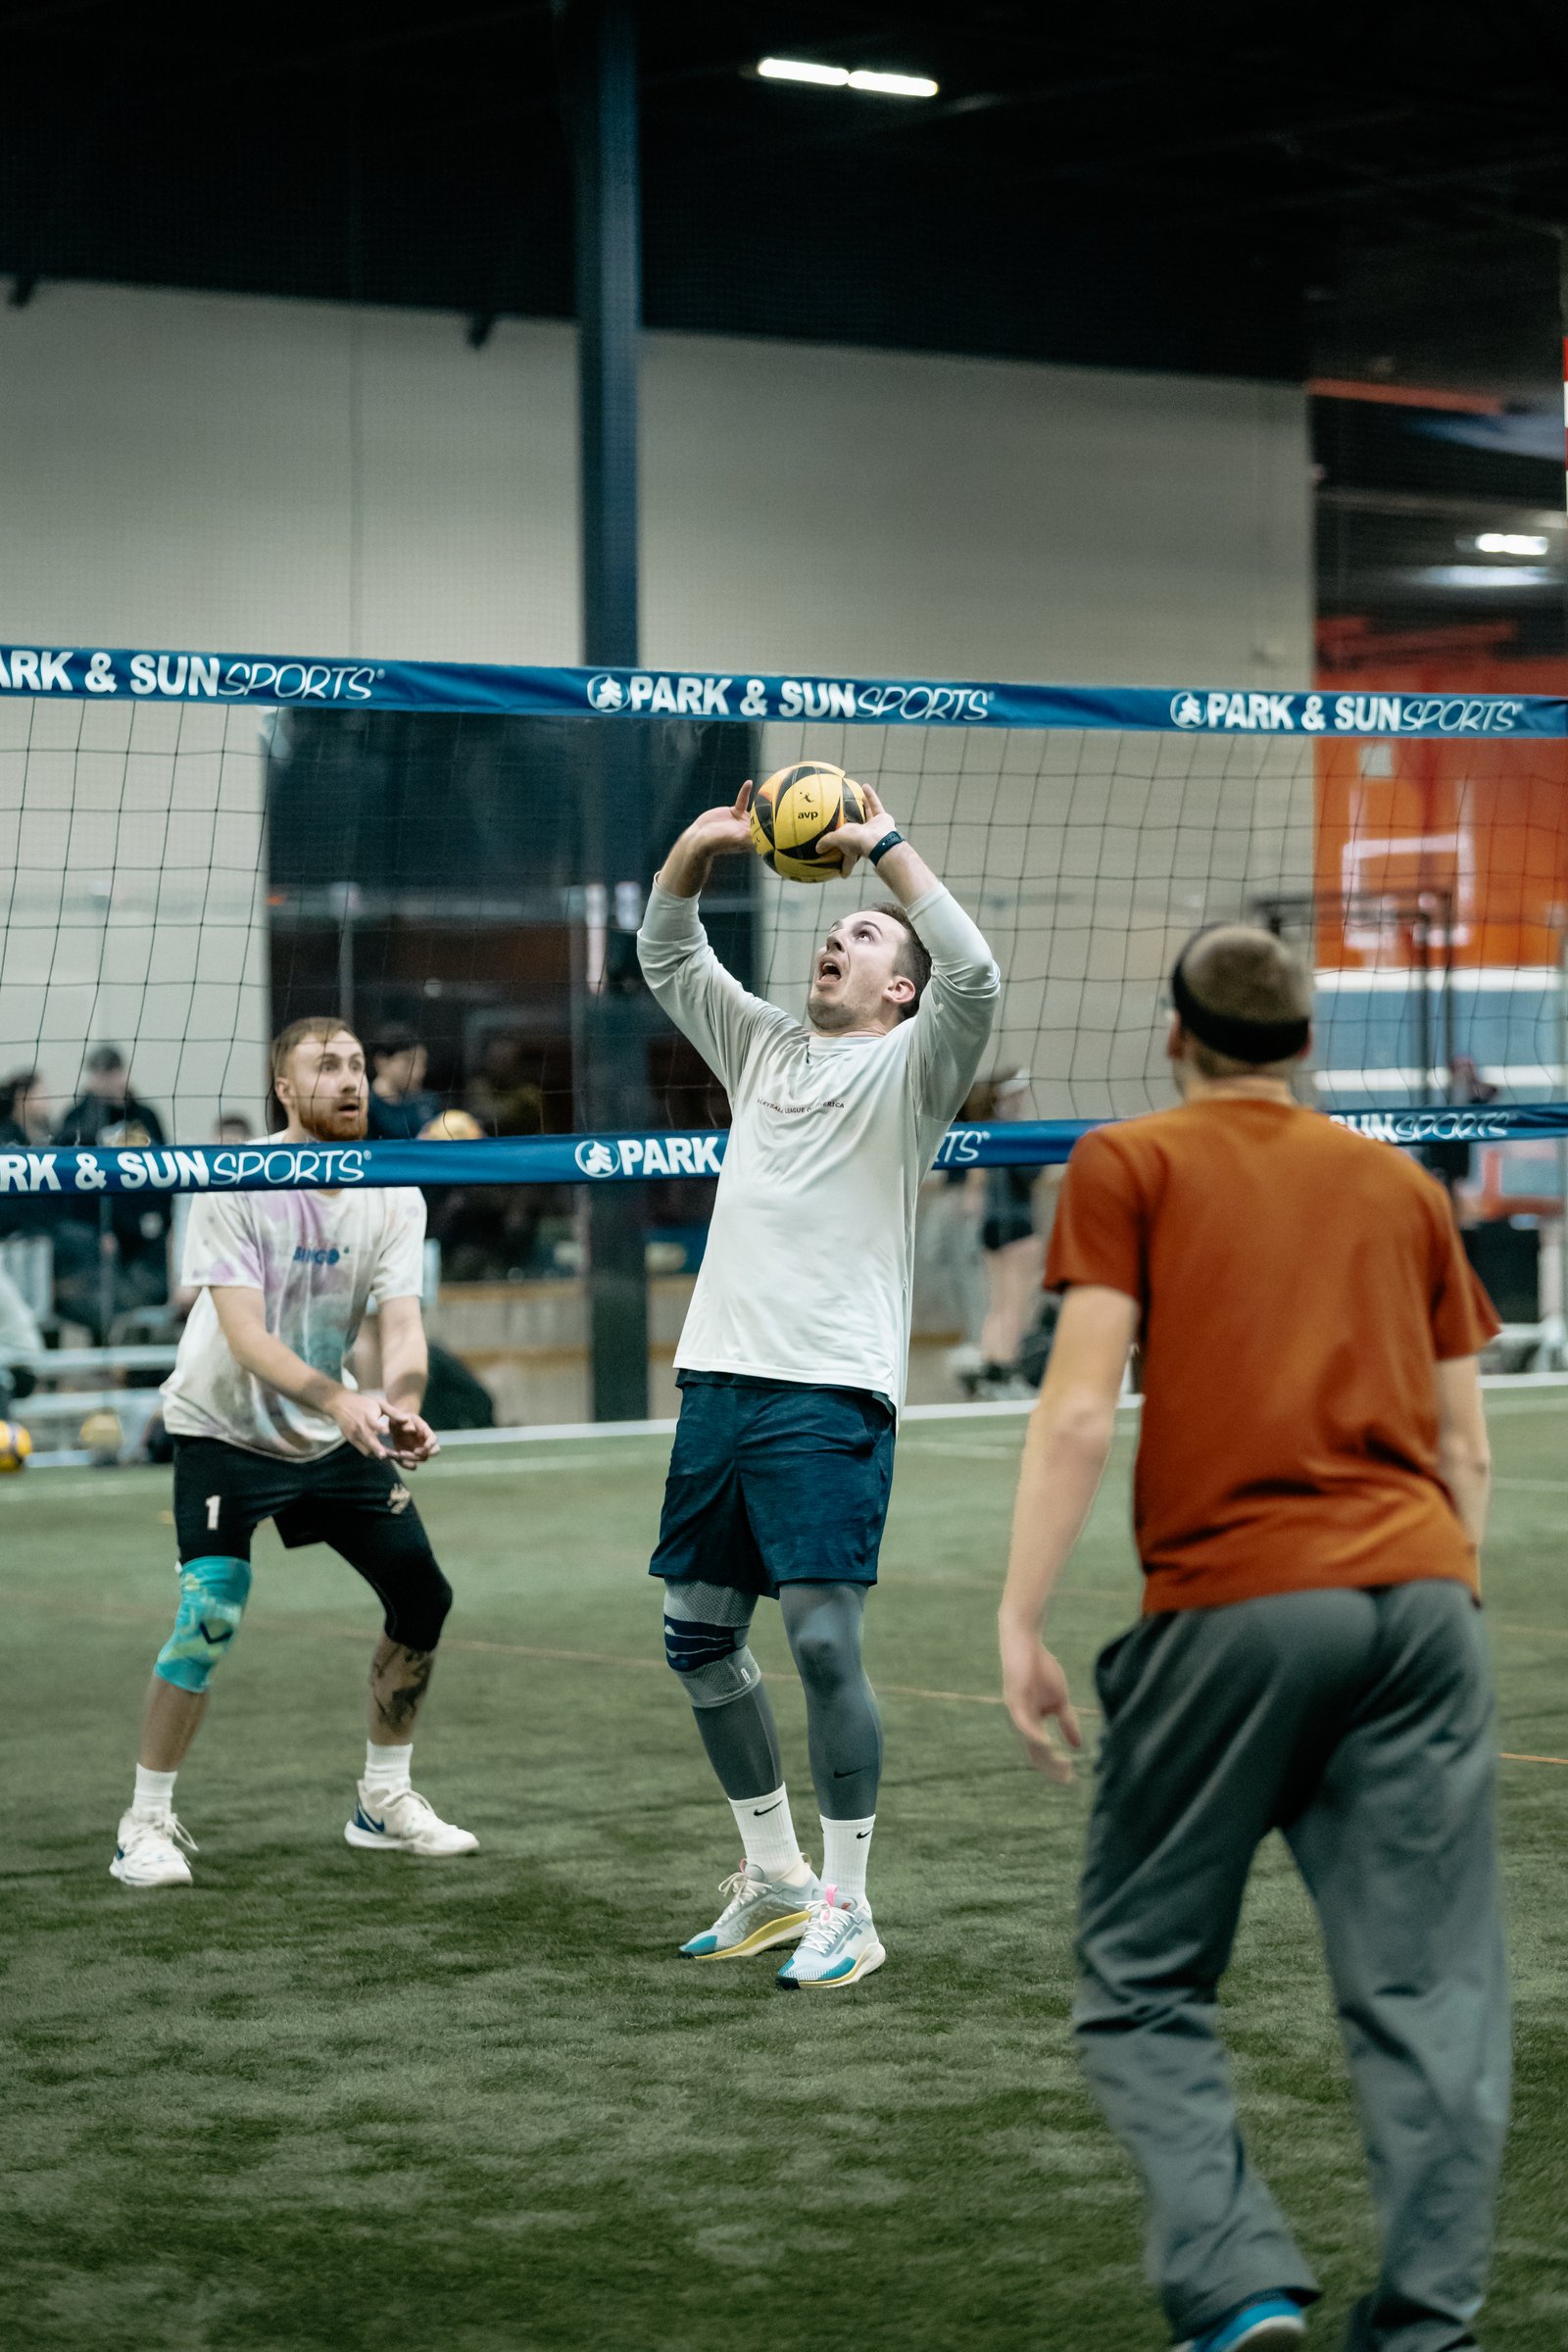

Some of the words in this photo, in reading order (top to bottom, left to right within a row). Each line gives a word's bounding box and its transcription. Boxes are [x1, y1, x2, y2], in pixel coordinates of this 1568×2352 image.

[84, 652, 117, 694] &
[130, 656, 220, 697] SUN
[219, 662, 372, 700] SPORTS
[630, 676, 732, 716] PARK
[739, 680, 768, 716] &
[779, 680, 857, 718] SUN
[856, 686, 989, 721] SPORTS
[1206, 693, 1295, 730] PARK
[1300, 696, 1326, 731] &
[1334, 695, 1401, 732] SUN
[1400, 699, 1519, 732] SPORTS
[797, 810, 818, 820] avp
[75, 1152, 107, 1190] &
[119, 1150, 211, 1189] SUN
[210, 1149, 366, 1186] SPORTS
[618, 1136, 720, 1176] PARK
[205, 1494, 221, 1531] 1
